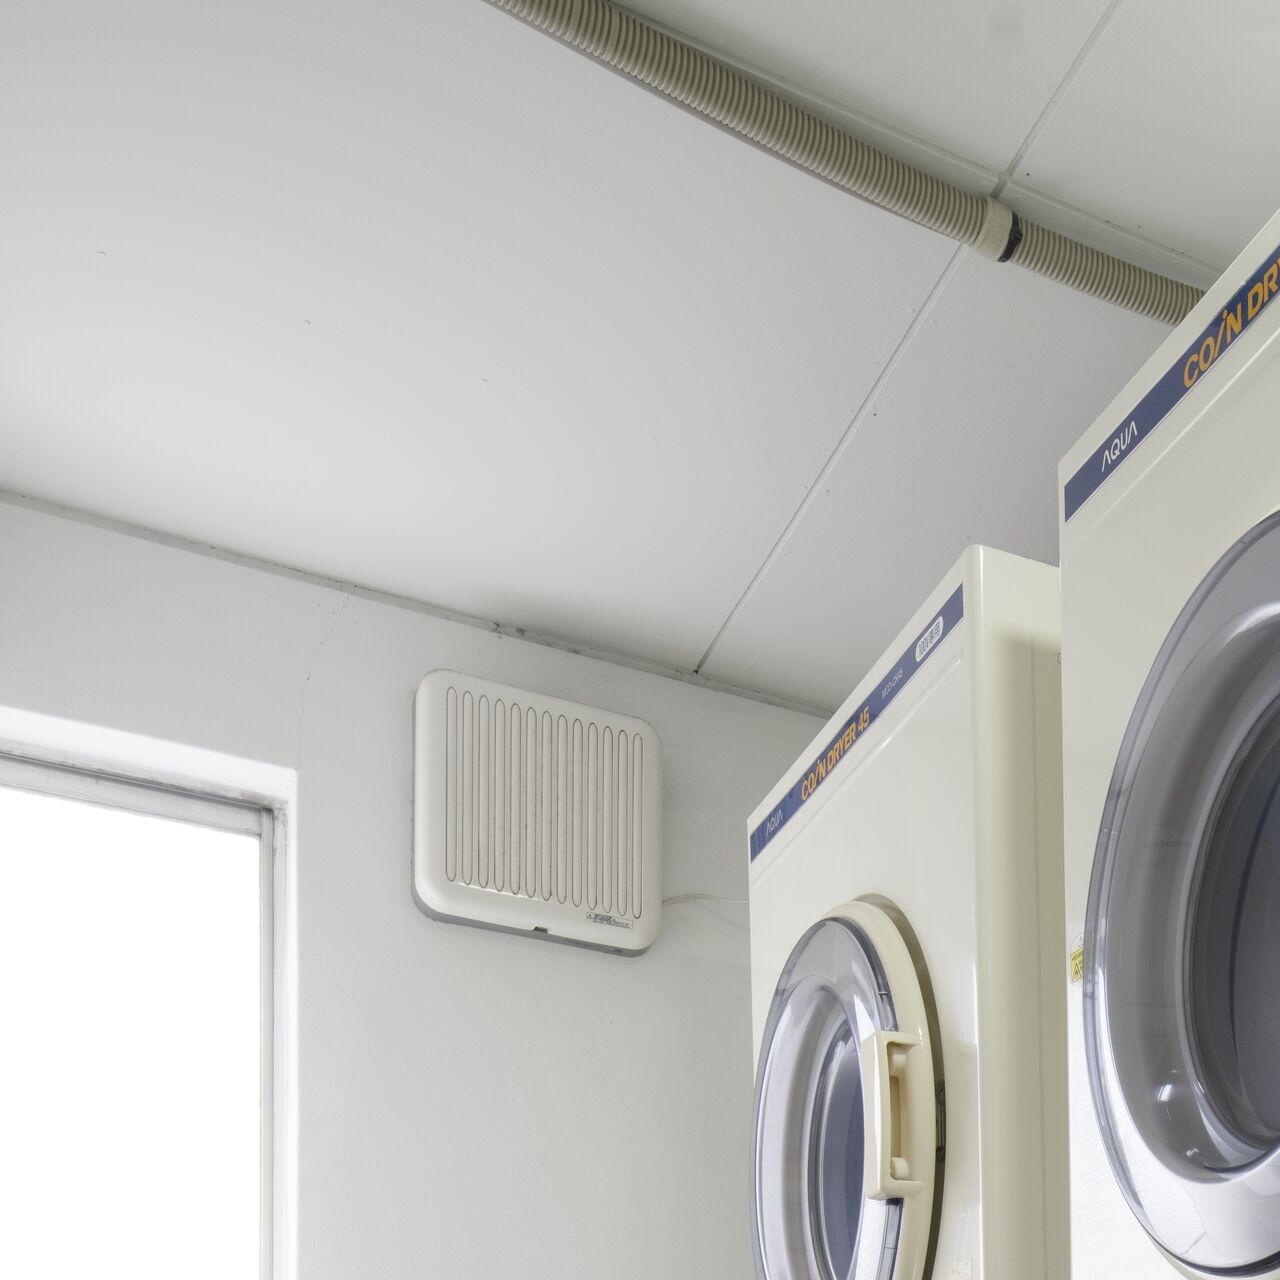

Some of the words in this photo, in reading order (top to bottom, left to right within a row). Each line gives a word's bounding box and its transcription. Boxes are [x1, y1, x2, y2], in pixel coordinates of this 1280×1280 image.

[1101, 420, 1138, 472] AQUA
[827, 723, 856, 772] DRYER
[858, 705, 870, 733] 45
